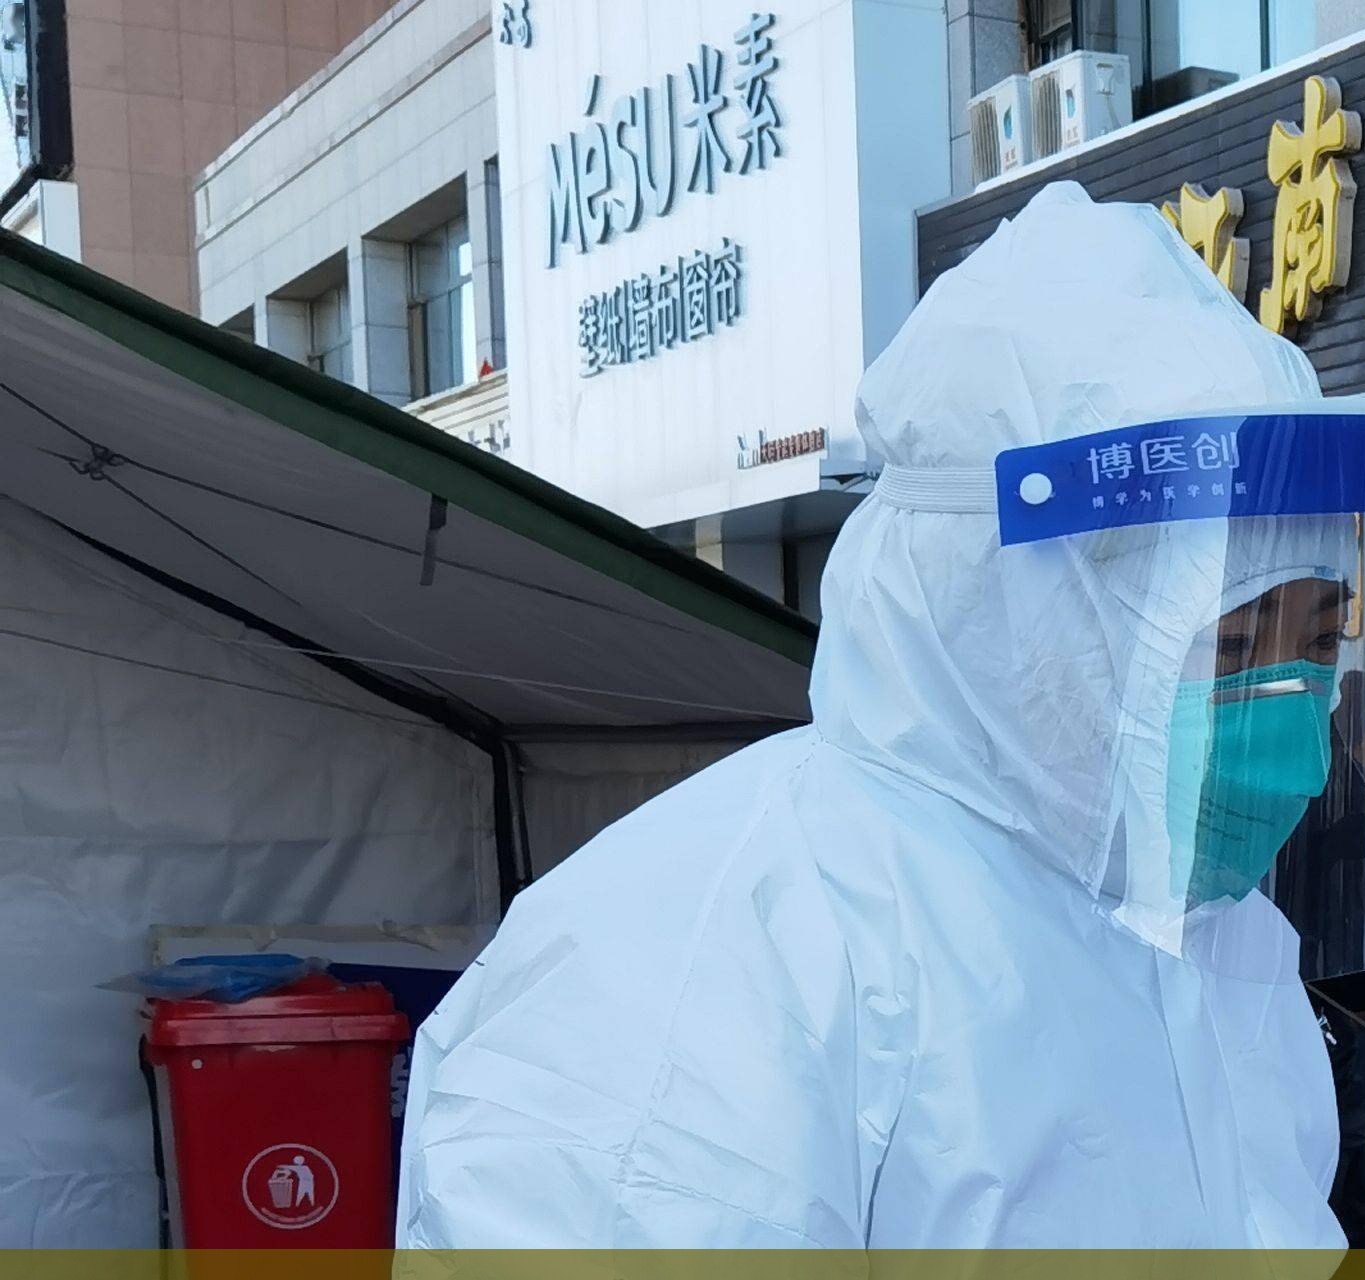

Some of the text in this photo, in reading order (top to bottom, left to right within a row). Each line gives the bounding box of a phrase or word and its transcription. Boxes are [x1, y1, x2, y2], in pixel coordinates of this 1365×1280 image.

[685, 13, 784, 195] 米素
[1087, 432, 1240, 484] 博医创
